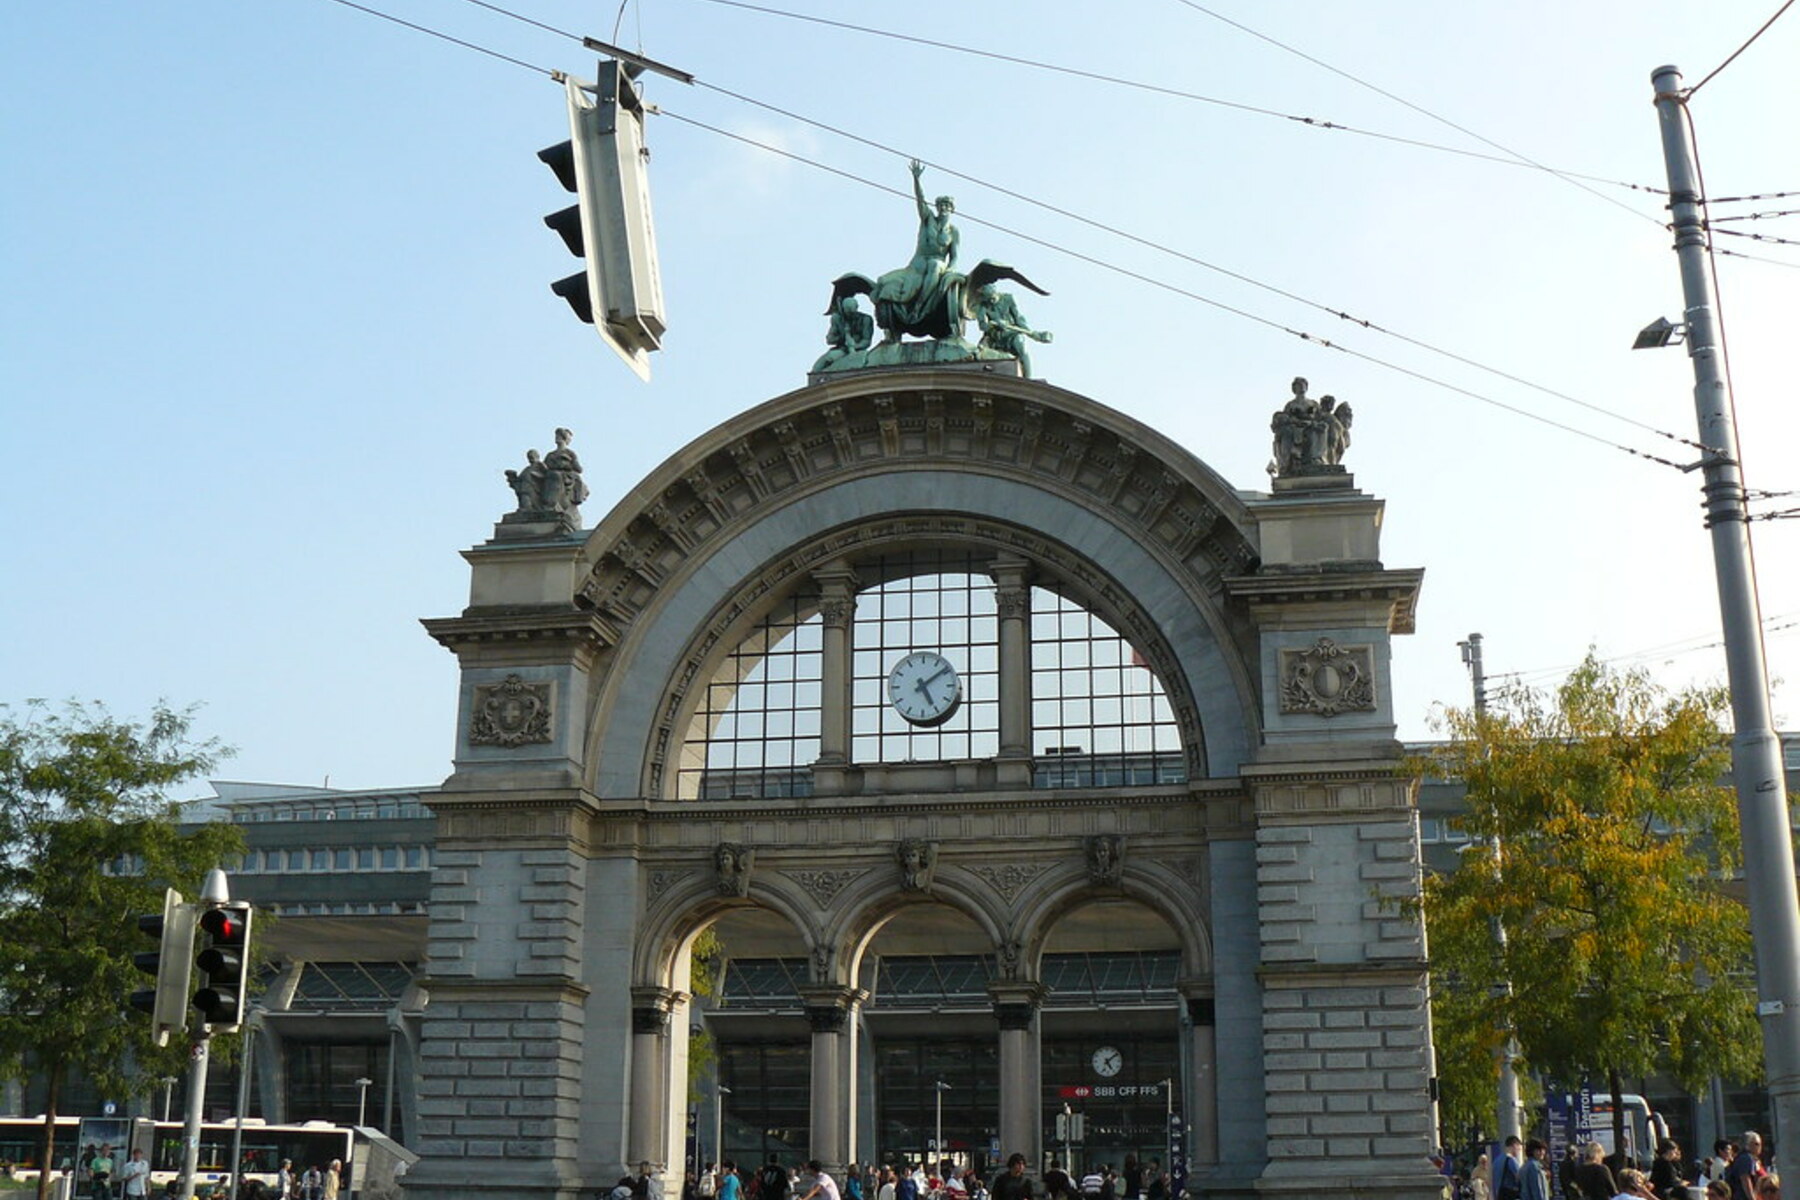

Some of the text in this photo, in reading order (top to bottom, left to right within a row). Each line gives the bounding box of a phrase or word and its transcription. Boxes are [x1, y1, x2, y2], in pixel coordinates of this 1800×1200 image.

[1094, 1086, 1158, 1096] SBB CFF FFS
